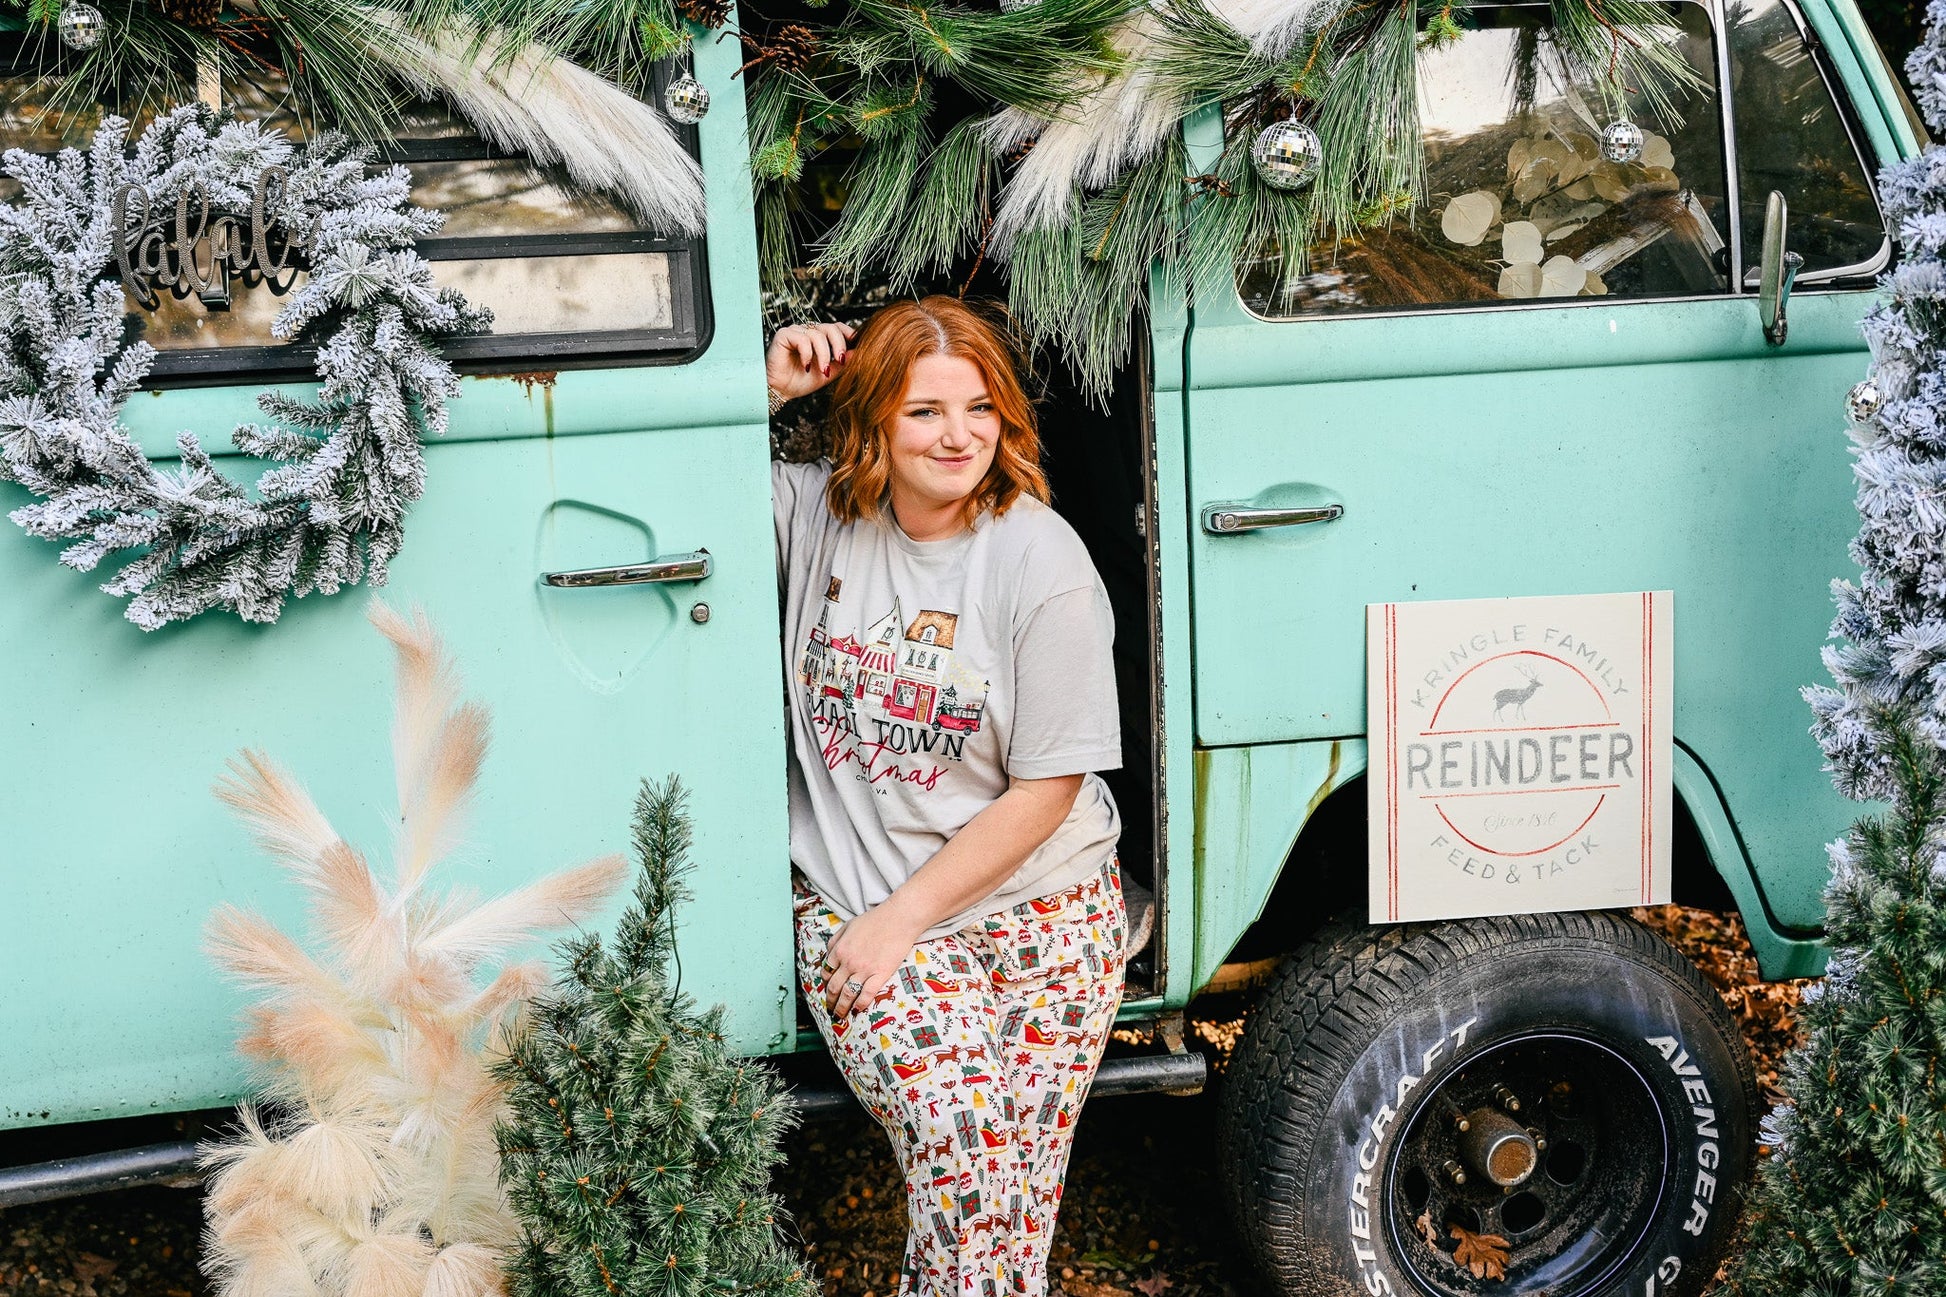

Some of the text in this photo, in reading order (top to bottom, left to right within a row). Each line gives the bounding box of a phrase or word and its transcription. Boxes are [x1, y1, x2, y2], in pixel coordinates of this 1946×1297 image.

[1411, 624, 1629, 709] KRINGLE FAMILY
[806, 692, 965, 759] MALL TOWN
[1406, 732, 1634, 791] REINDEER
[1430, 834, 1600, 885] FEED & TACK
[1350, 1017, 1478, 1297] STERCRAFT
[1645, 1035, 1721, 1237] AVENGER
